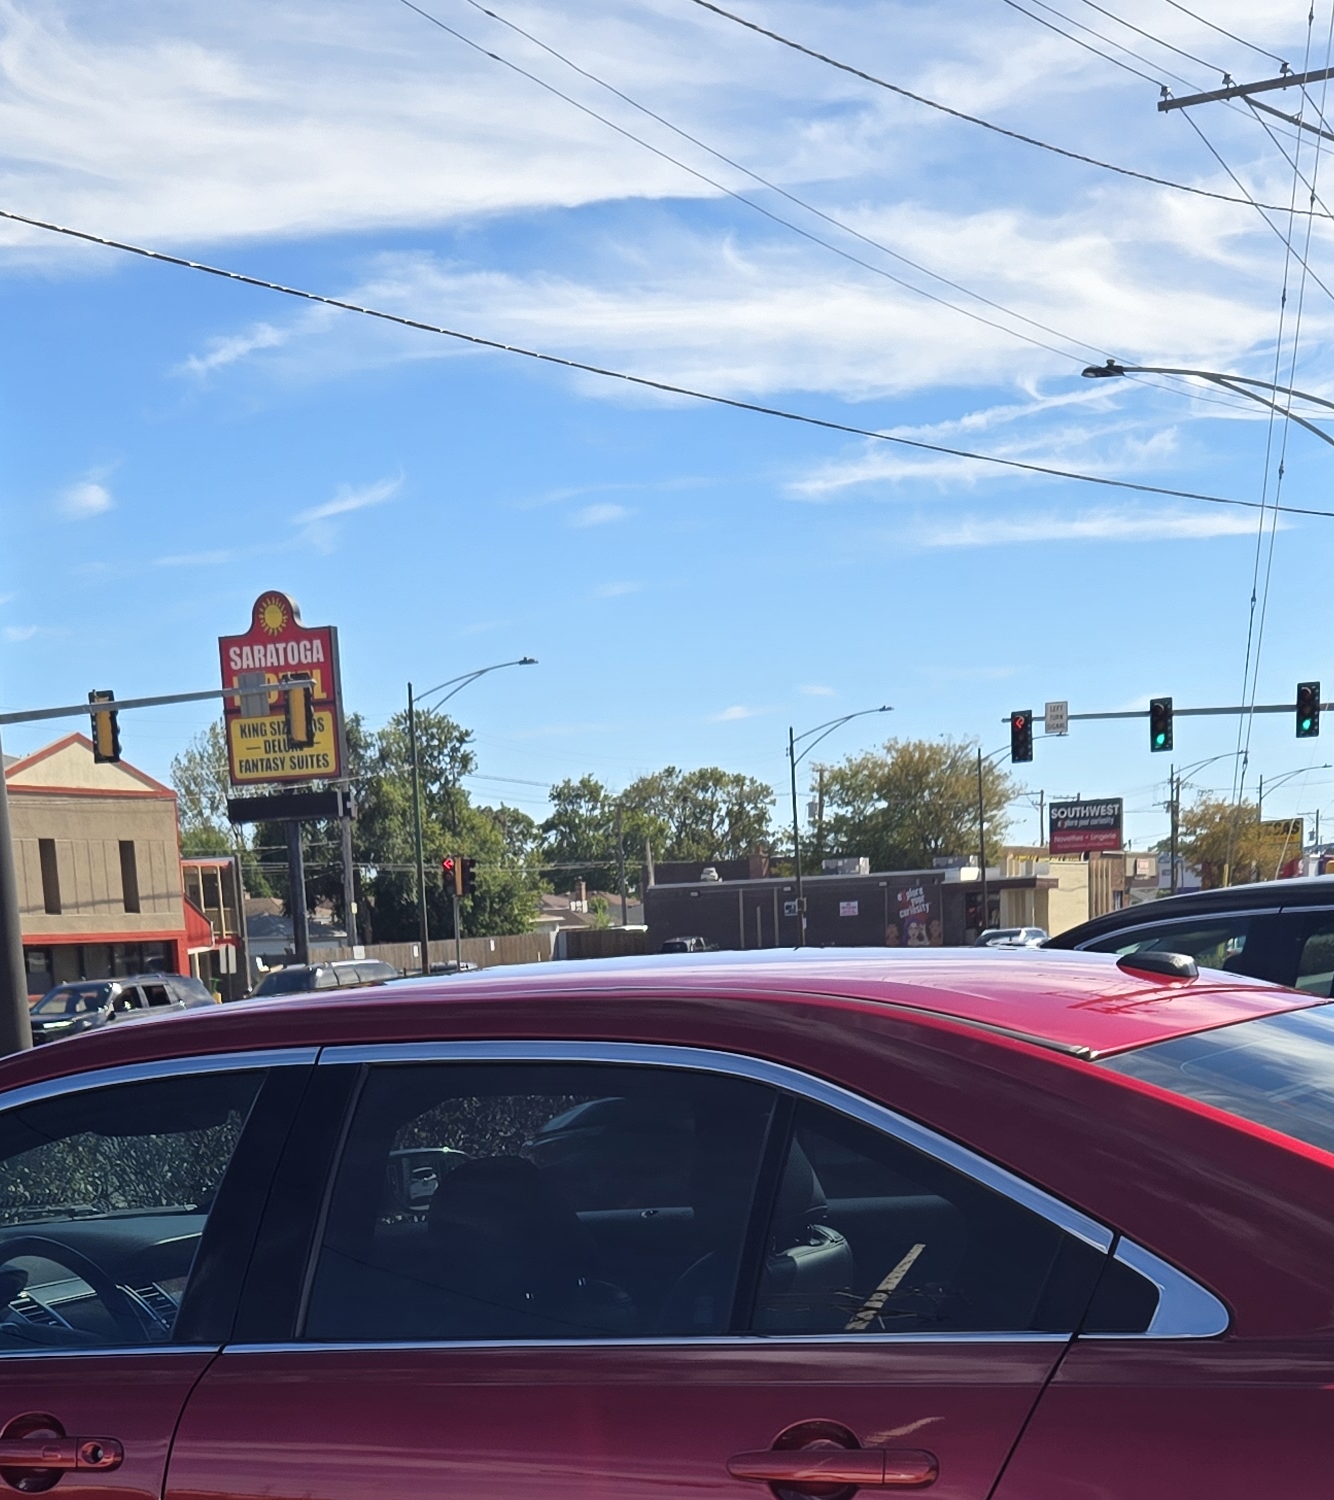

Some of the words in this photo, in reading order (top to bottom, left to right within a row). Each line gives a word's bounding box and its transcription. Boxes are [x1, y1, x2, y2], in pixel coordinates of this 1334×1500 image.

[229, 639, 325, 670] SARATOGA
[240, 722, 267, 739] KING
[239, 757, 285, 774] FANTASY
[289, 753, 330, 771] SUITES
[1051, 804, 1120, 819] SOUTHWEST
